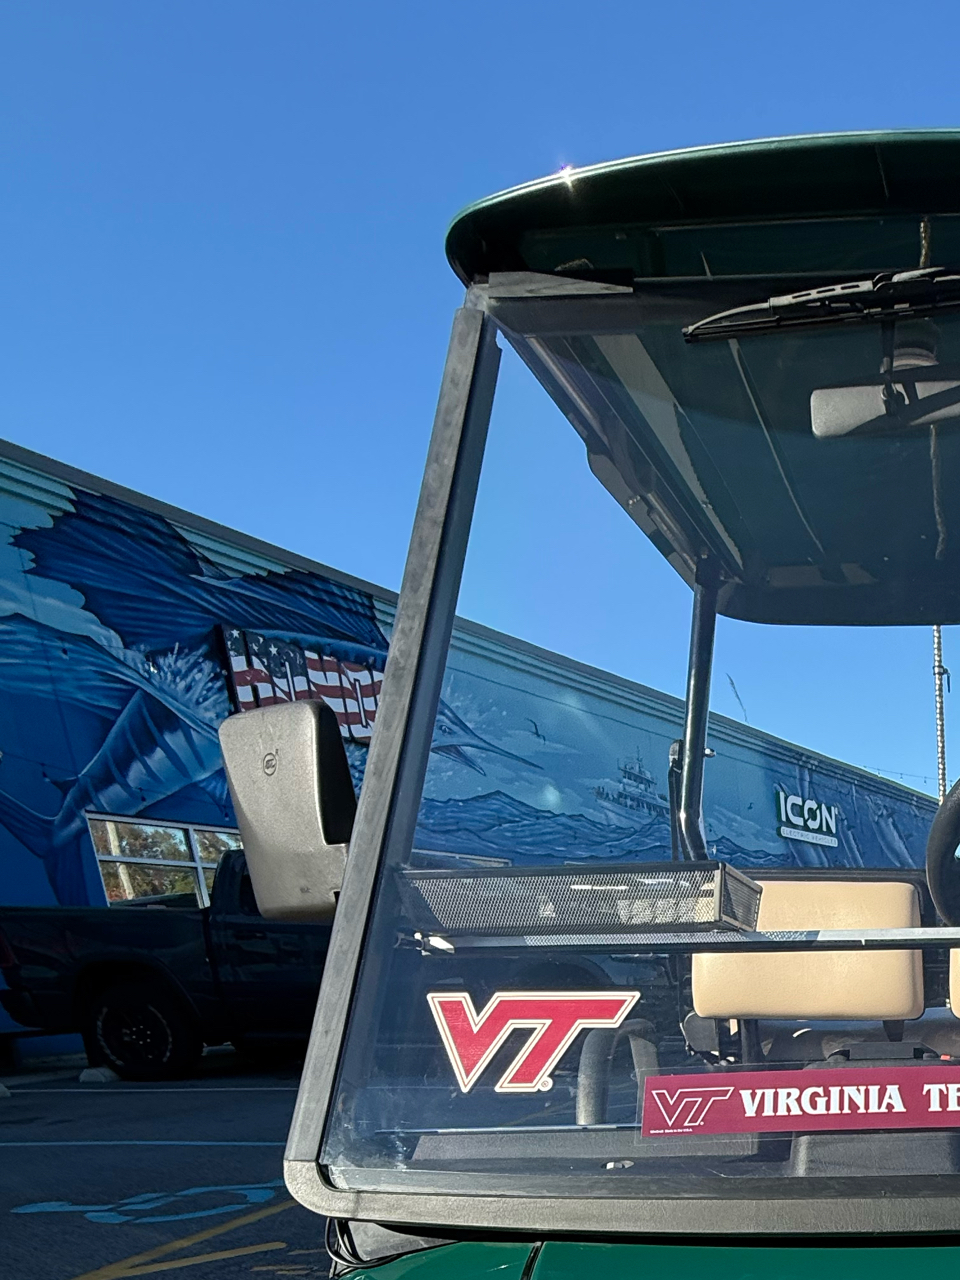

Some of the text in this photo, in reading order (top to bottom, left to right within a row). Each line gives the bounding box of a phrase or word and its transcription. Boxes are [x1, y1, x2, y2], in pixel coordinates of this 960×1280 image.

[780, 791, 837, 834] ICON
[782, 828, 810, 840] ELECTRIC
[427, 991, 641, 1093] VT
[652, 1086, 735, 1127] VT
[739, 1084, 907, 1118] VIRGINIA
